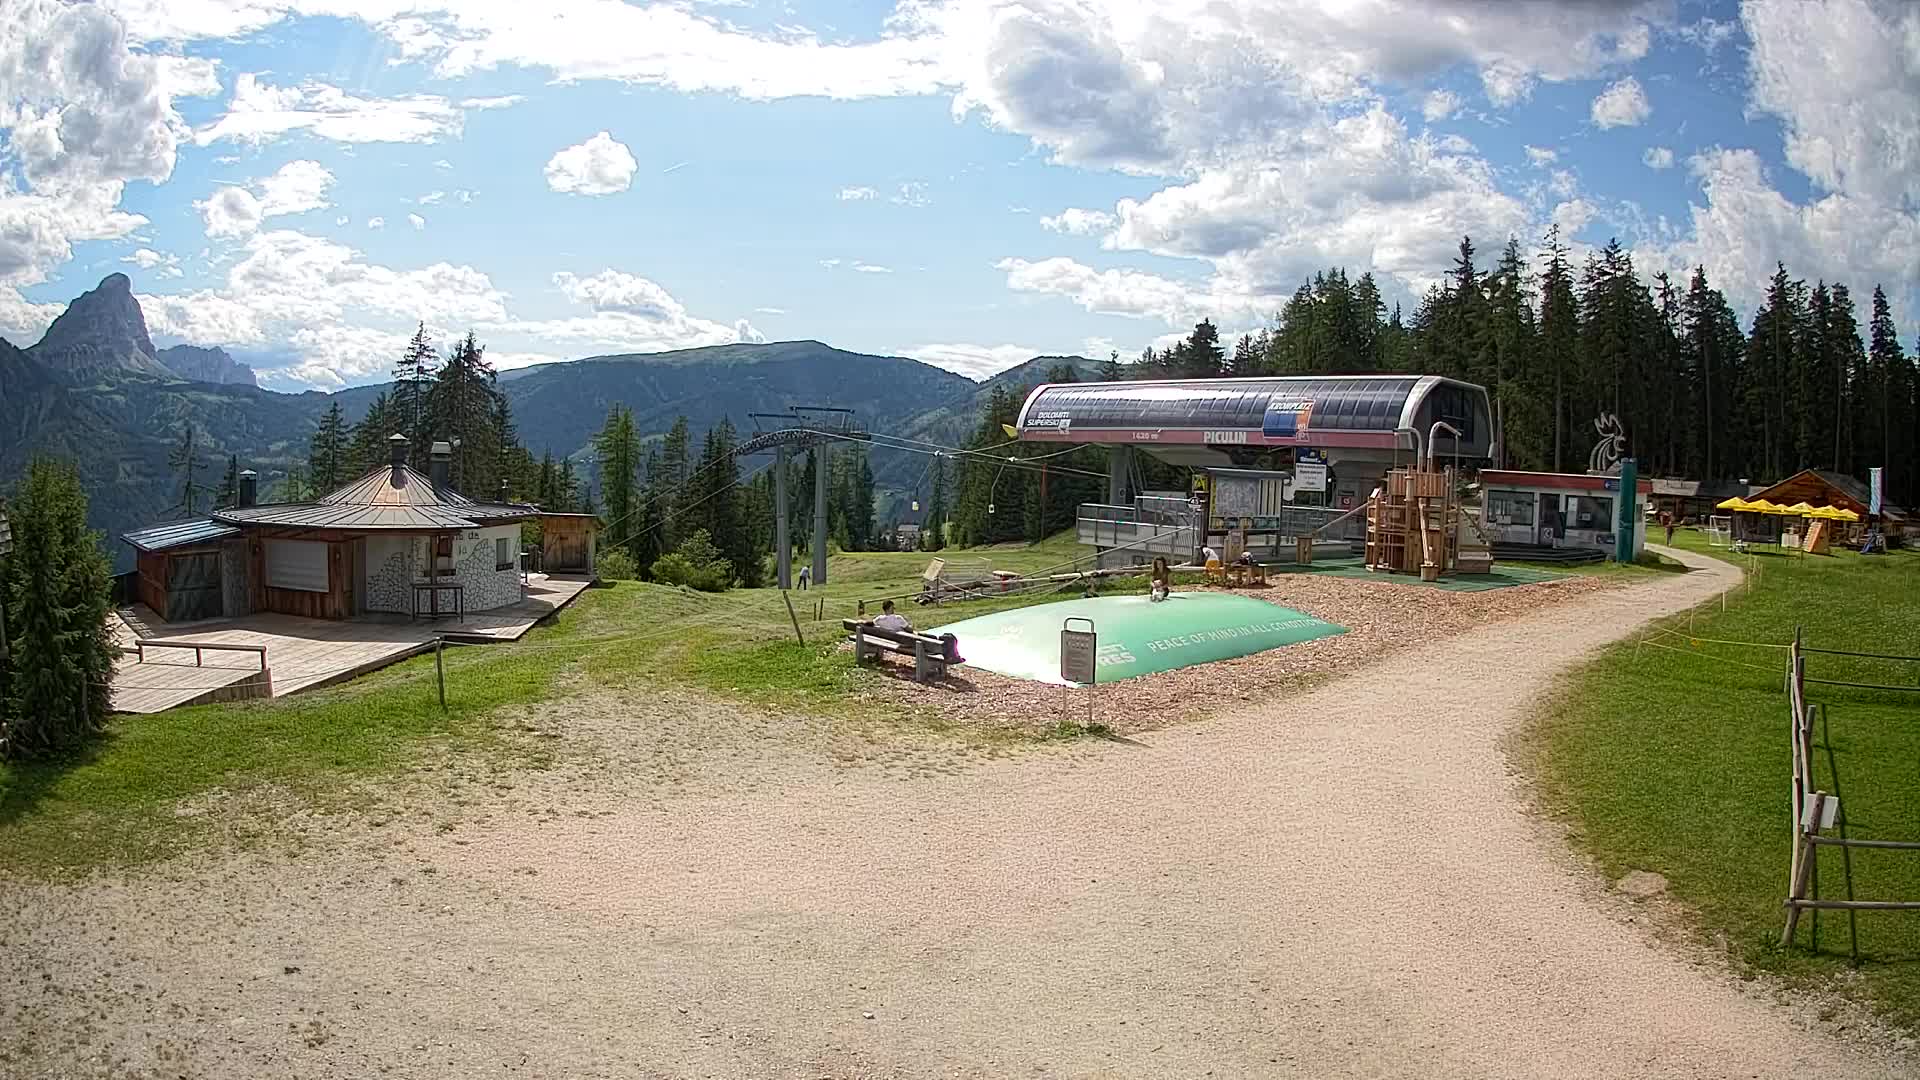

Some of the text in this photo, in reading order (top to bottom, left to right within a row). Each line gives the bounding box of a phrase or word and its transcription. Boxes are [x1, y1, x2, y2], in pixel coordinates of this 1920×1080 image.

[1203, 431, 1247, 444] PICULIN
[1146, 635, 1190, 653] PEACE
[1190, 632, 1206, 643] OF
[1207, 628, 1238, 641] MIND
[1251, 624, 1271, 633] ALL
